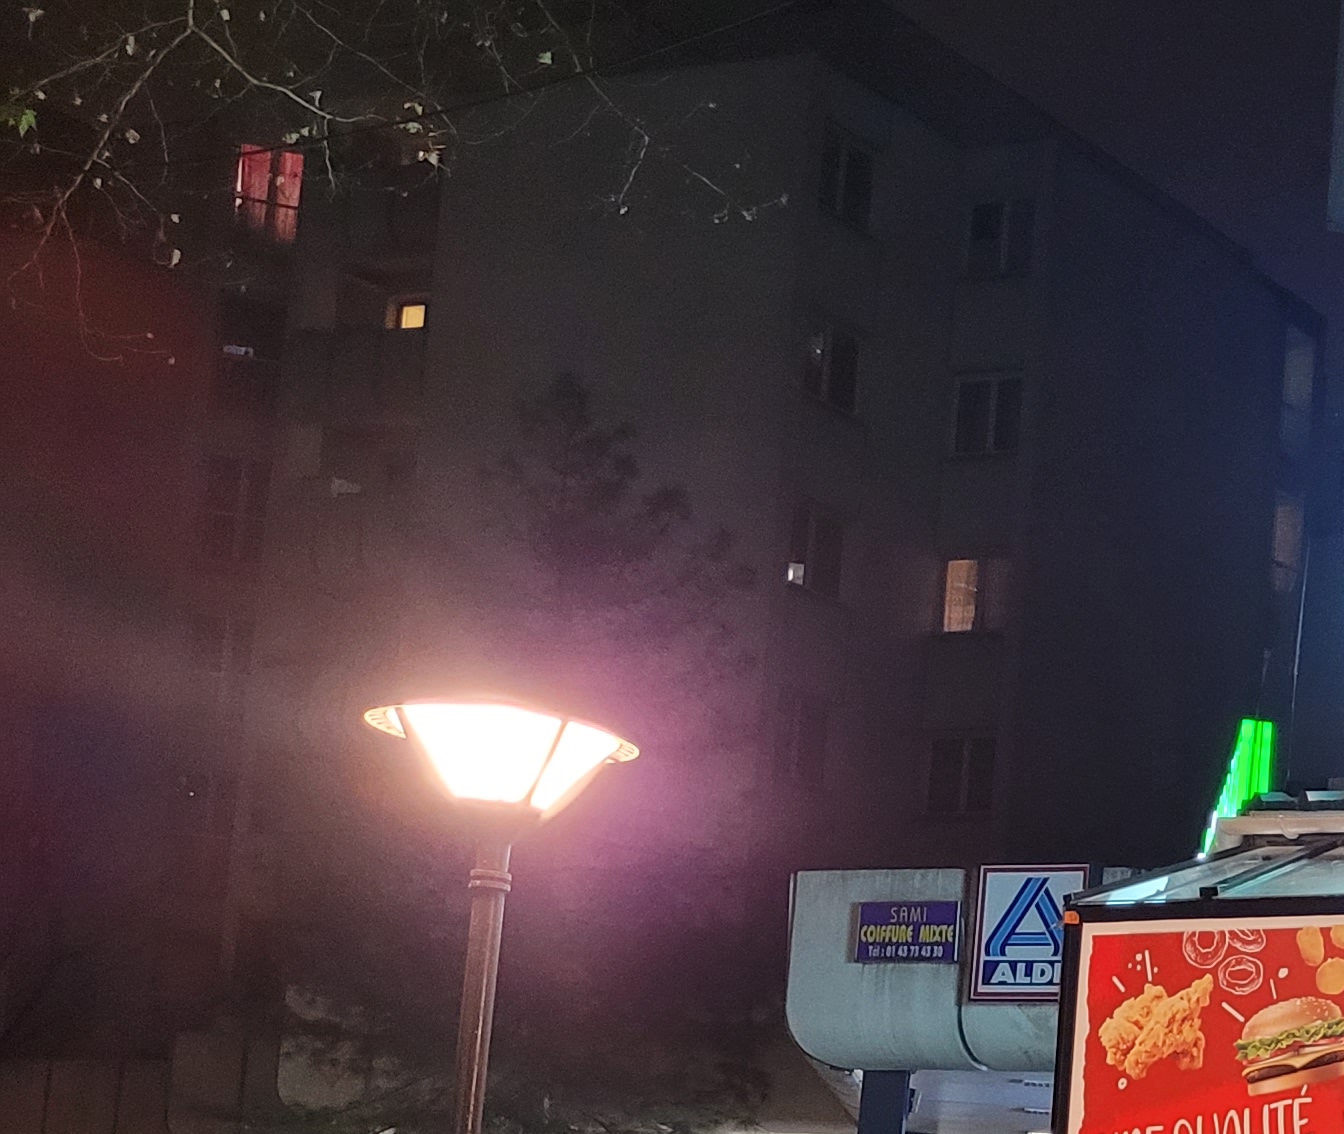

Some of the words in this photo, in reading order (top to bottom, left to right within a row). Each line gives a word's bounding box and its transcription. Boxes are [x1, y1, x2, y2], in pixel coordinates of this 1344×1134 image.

[890, 907, 927, 922] SAMI
[861, 925, 913, 943] COIFFURE
[919, 925, 954, 943] MIXTE
[886, 945, 896, 957] 01
[897, 945, 908, 957] 43
[910, 945, 919, 957] 73
[921, 945, 931, 957] 43
[933, 945, 943, 957] 30
[990, 962, 1061, 983] ALDI
